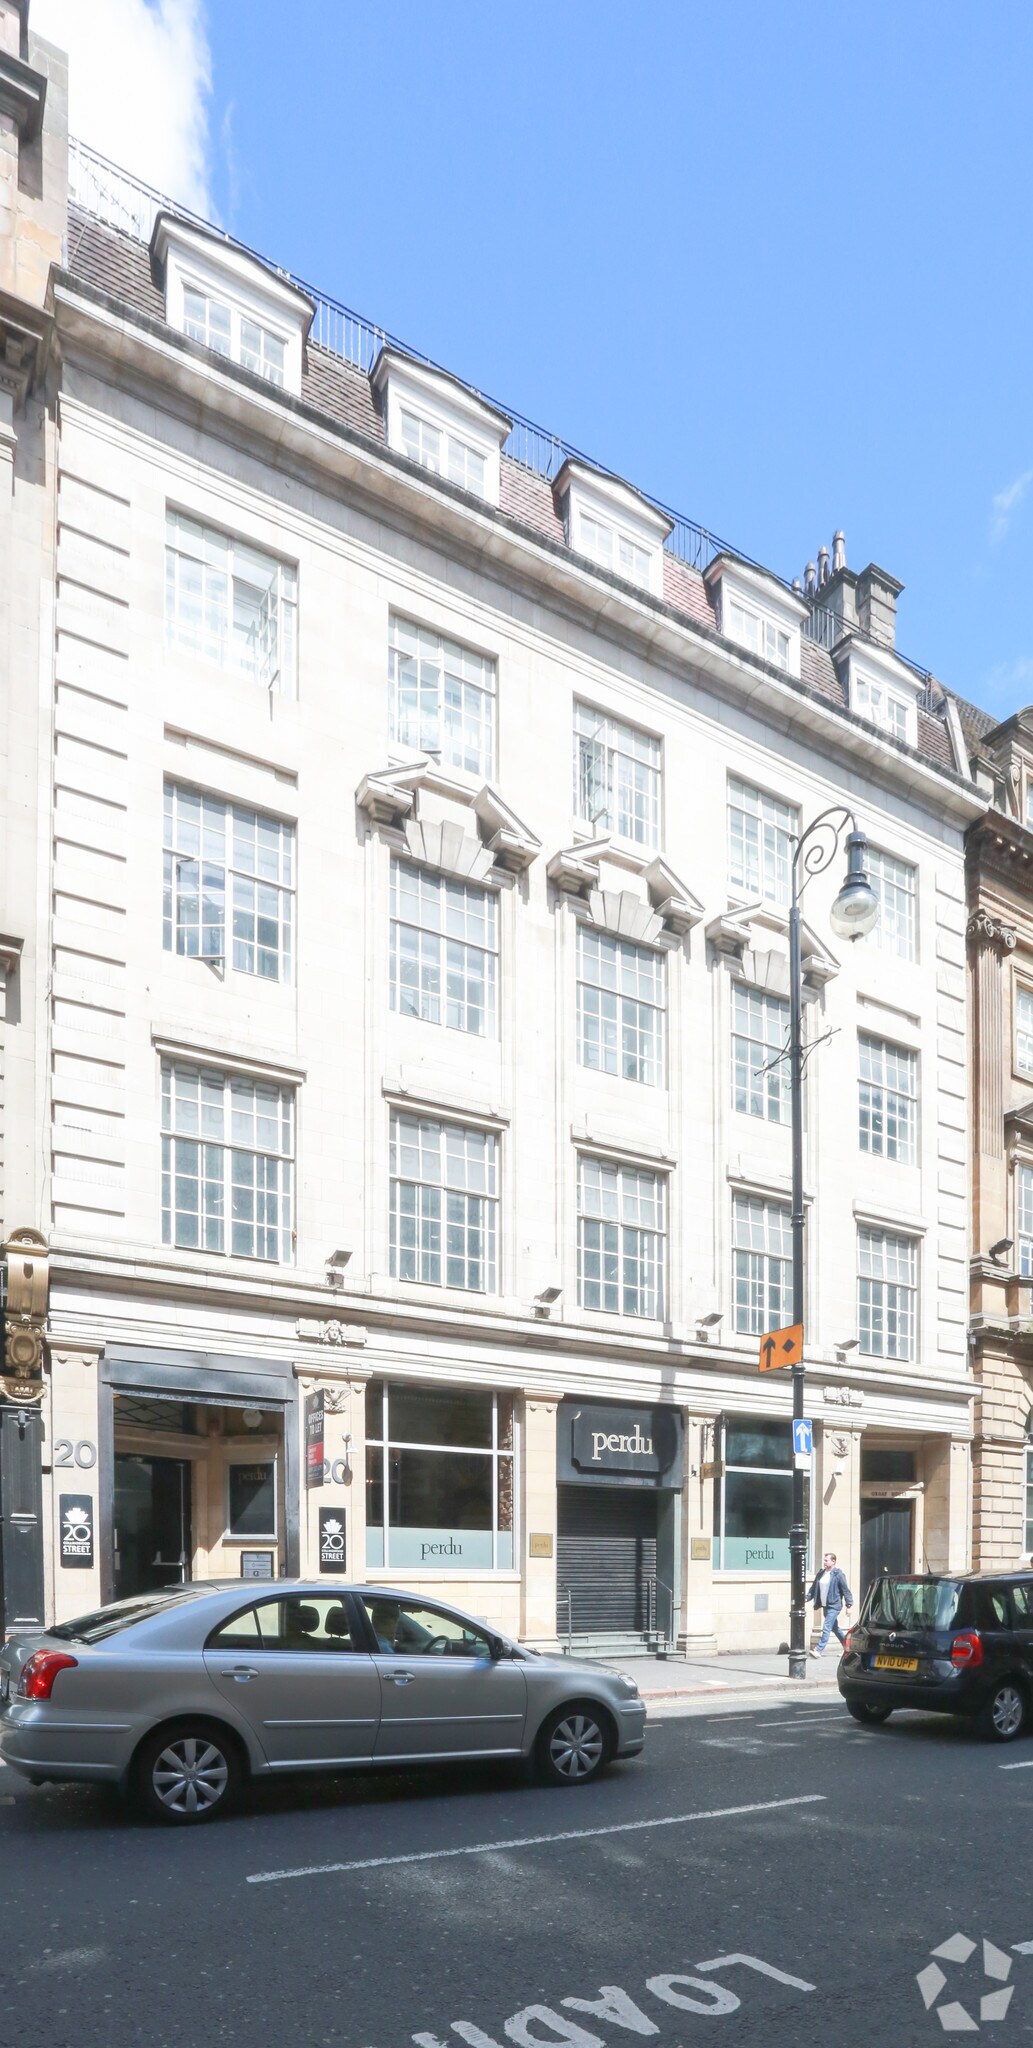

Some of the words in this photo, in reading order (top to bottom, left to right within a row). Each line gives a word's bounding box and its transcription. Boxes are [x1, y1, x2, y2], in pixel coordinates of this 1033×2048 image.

[591, 1424, 654, 1460] perdu
[54, 1440, 97, 1469] 20
[63, 1524, 91, 1541] 20
[321, 1534, 344, 1549] 20
[63, 1545, 91, 1553] STREET
[421, 1537, 463, 1560] perdu
[745, 1544, 774, 1564] perdu
[877, 1656, 895, 1667] NV10
[896, 1659, 914, 1669] UPF
